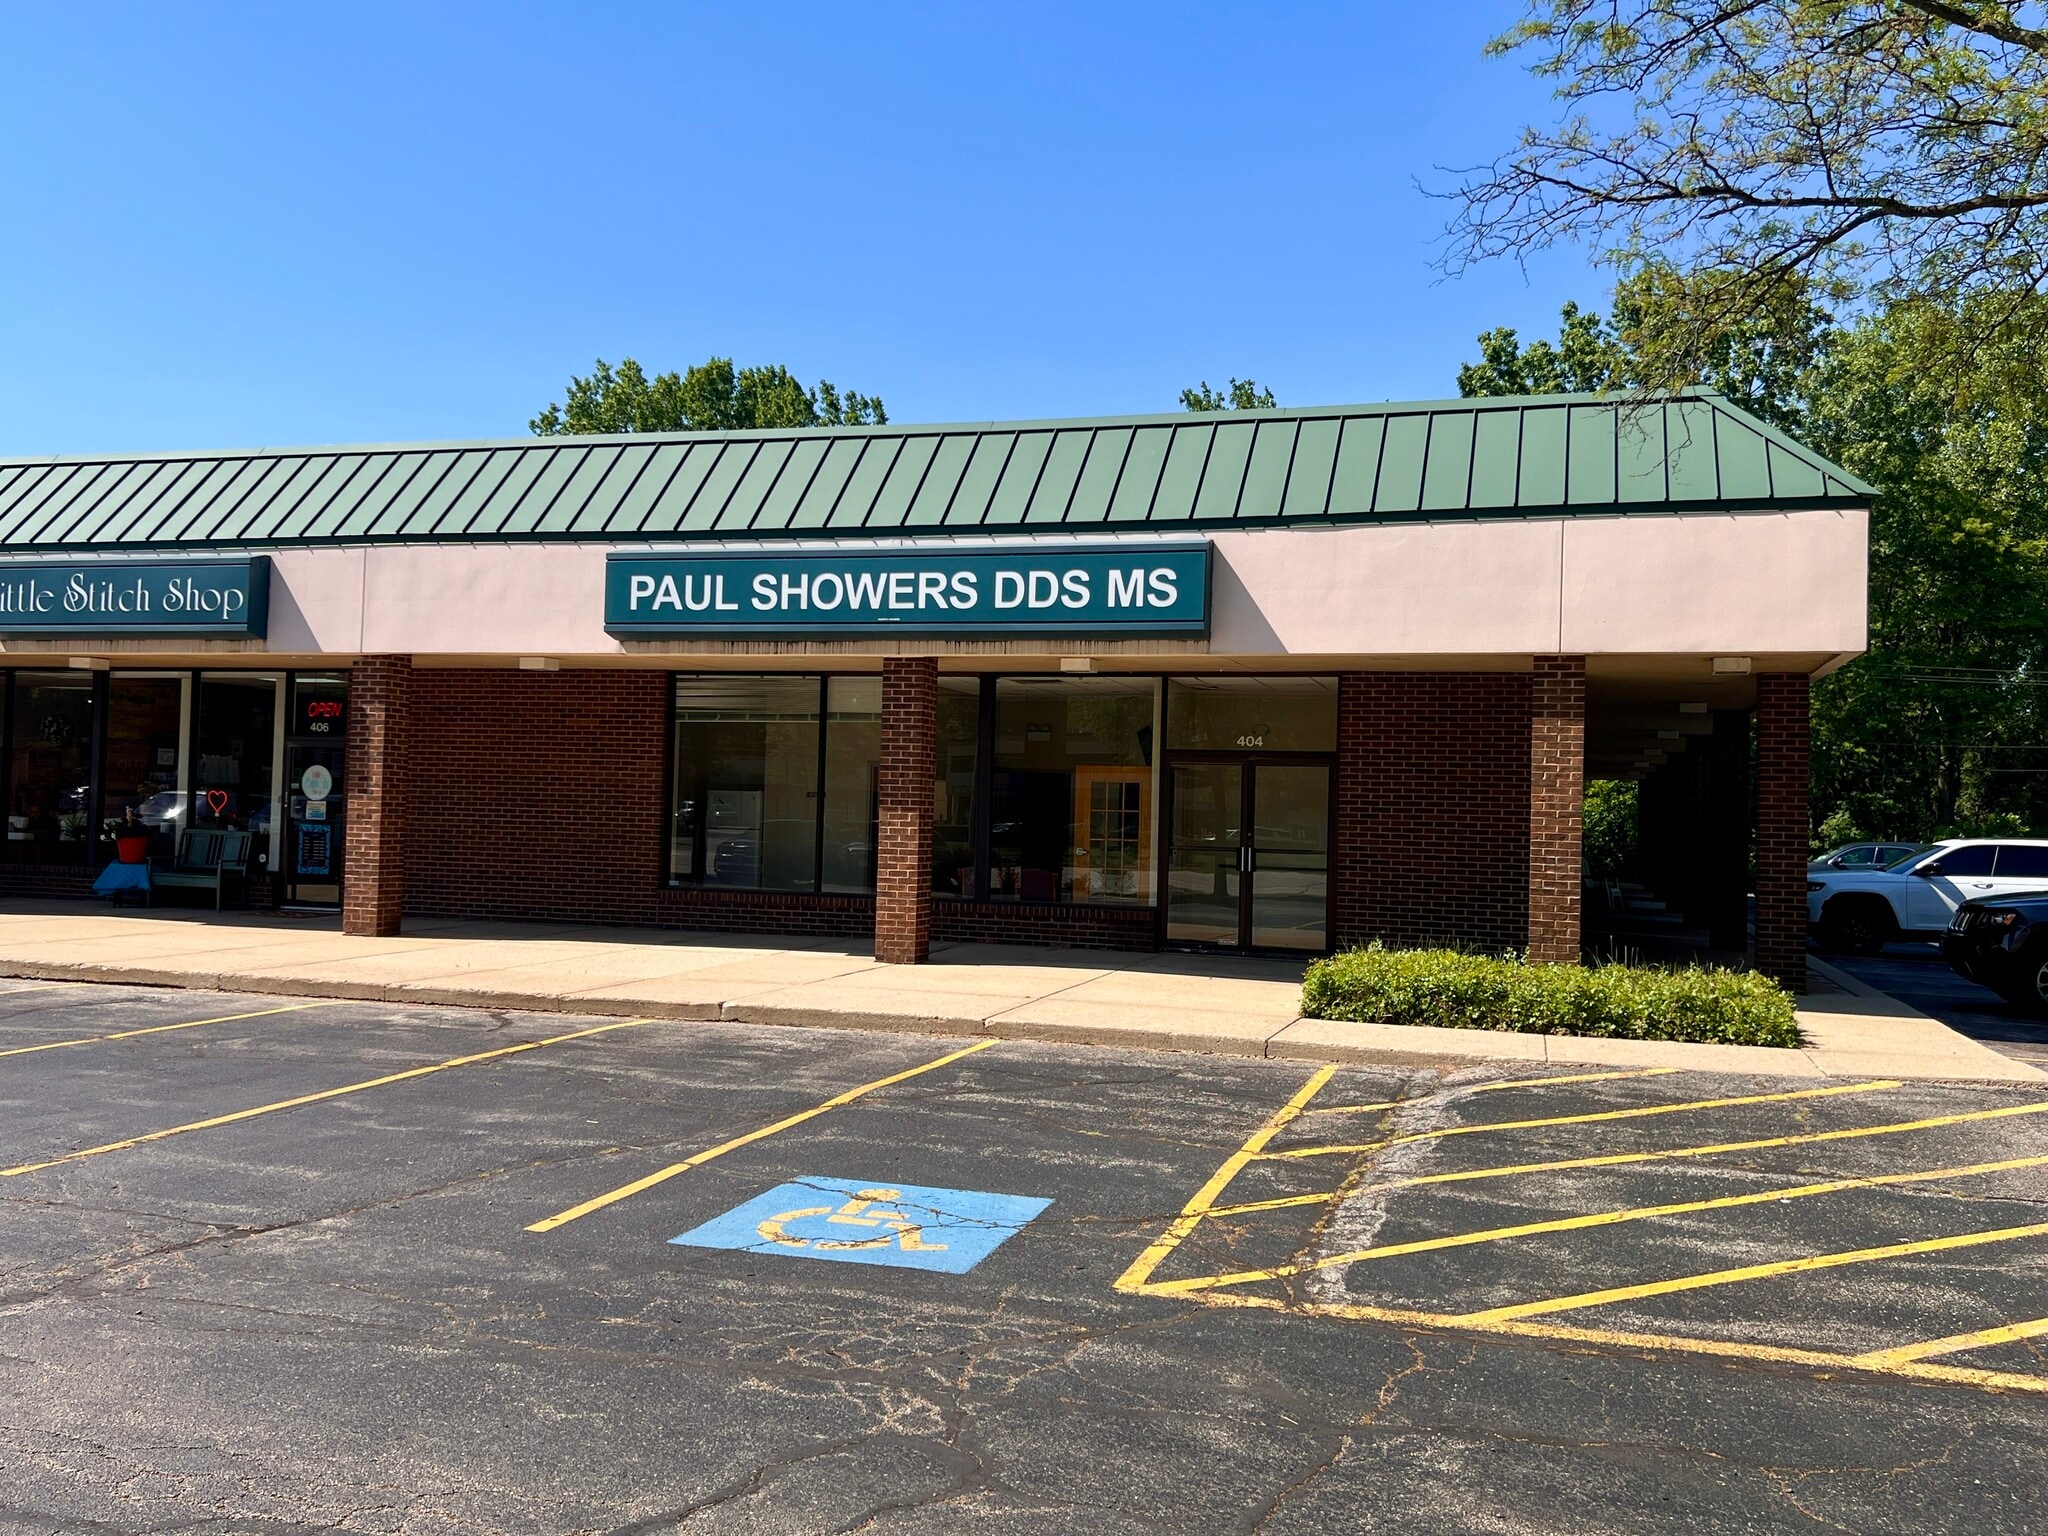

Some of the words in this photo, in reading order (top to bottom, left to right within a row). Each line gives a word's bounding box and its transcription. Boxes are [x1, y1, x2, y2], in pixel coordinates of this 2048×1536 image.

[63, 571, 150, 612] Stitch
[162, 576, 244, 619] Shop
[630, 573, 739, 611] PAUL
[751, 571, 978, 611] SHOWERS
[994, 569, 1091, 609] DDS
[1107, 568, 1178, 608] MS
[308, 702, 342, 717] OPEN
[310, 722, 329, 732] 406
[1236, 735, 1263, 747] 404
